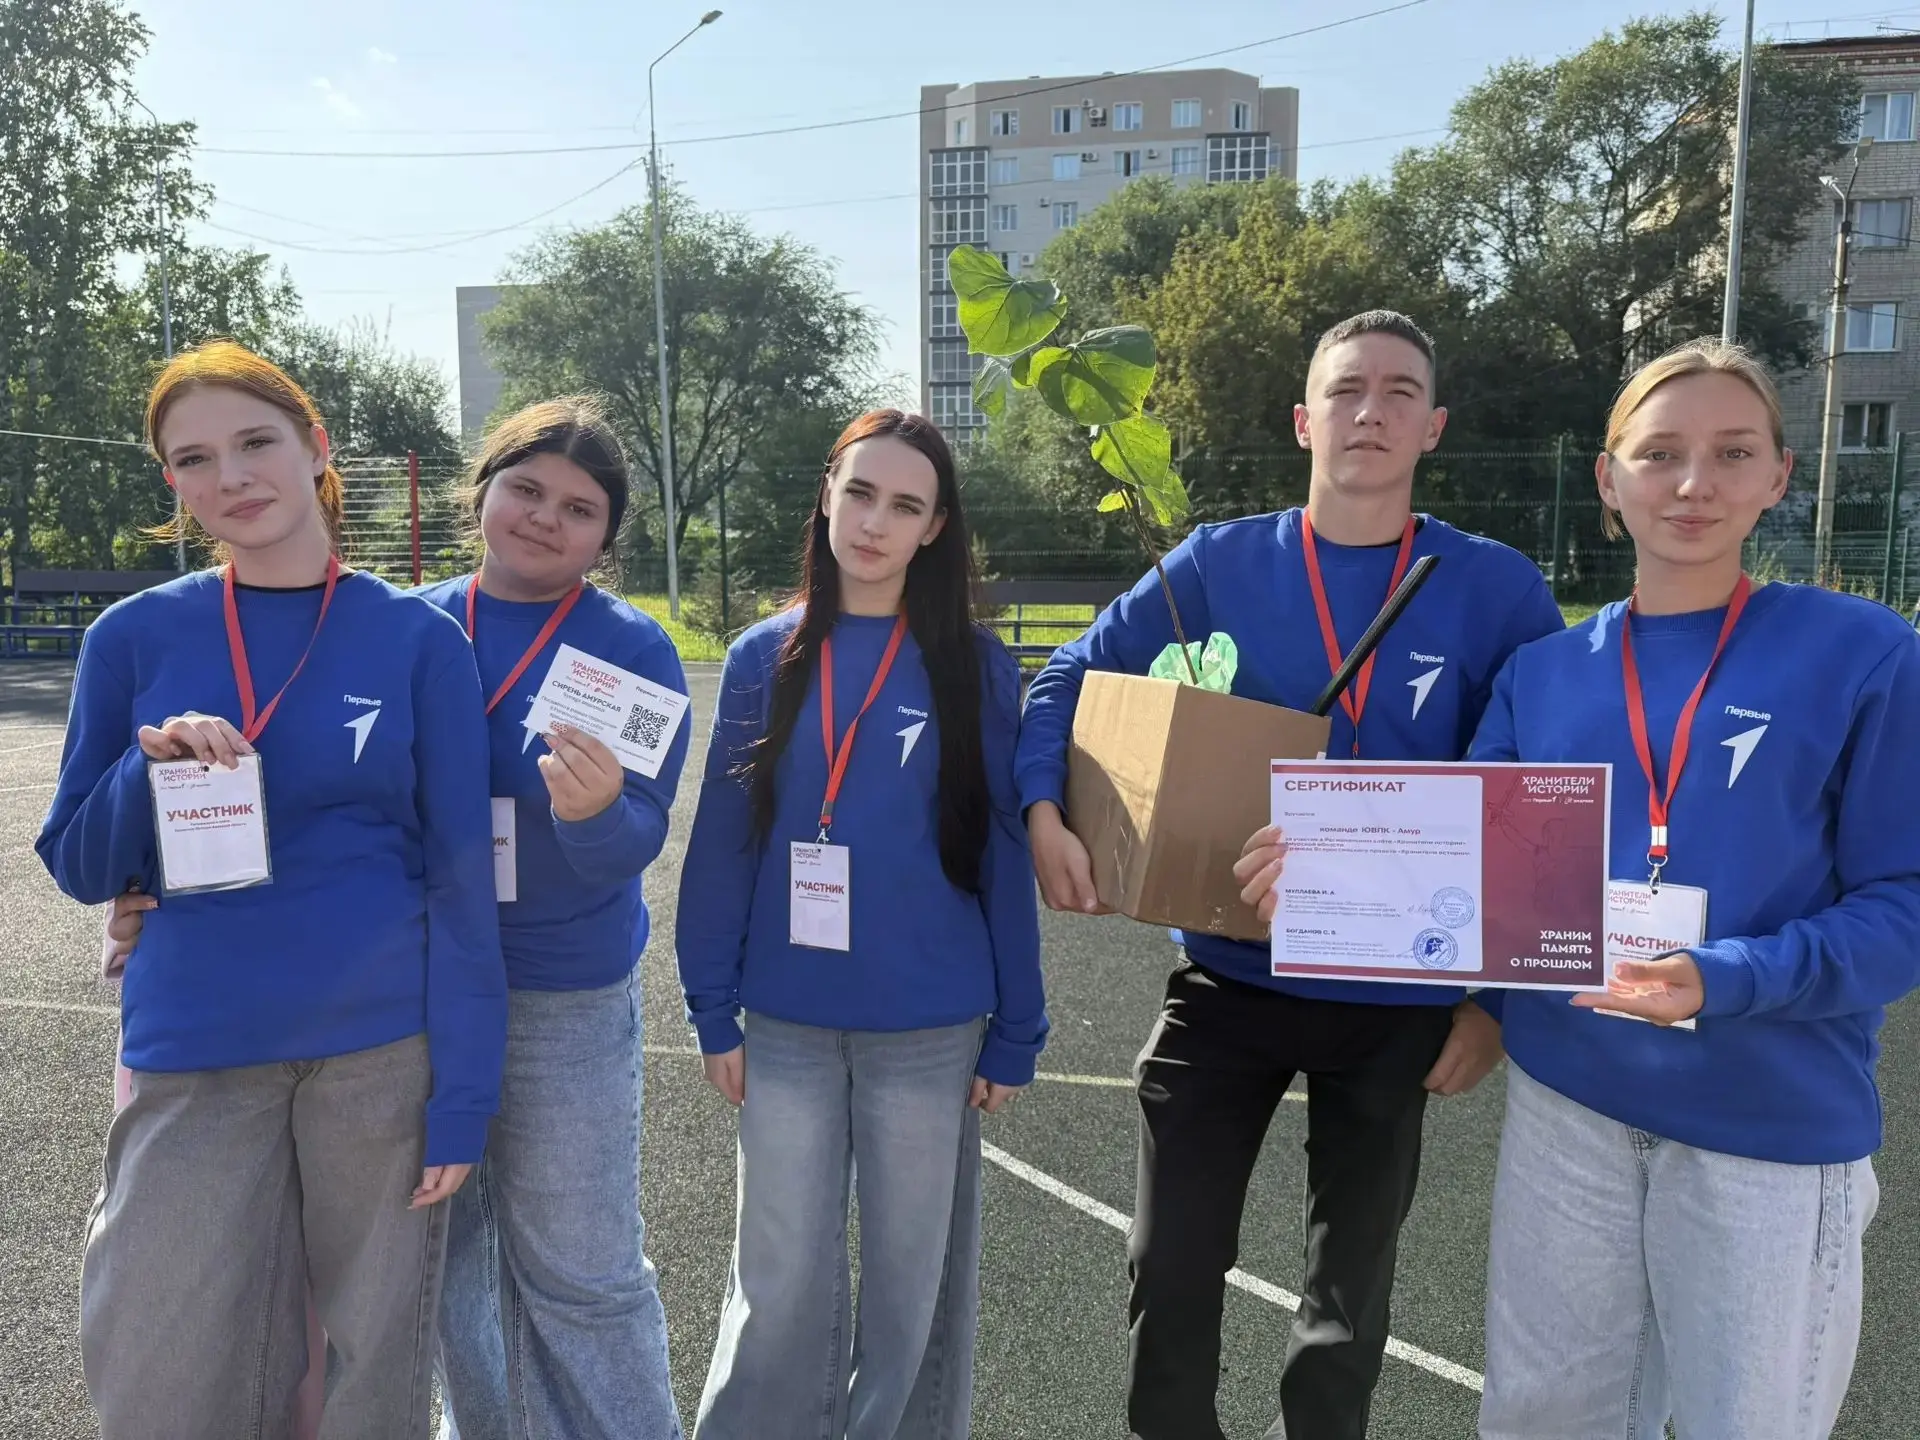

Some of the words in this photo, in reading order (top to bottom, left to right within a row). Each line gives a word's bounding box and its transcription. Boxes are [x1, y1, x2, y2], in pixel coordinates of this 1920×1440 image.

[571, 660, 621, 686] ХРАНИТЕЛИ
[572, 668, 615, 690] ИСТОРИИ
[343, 694, 382, 706] Первые
[552, 680, 581, 697] СИРЕНЬ
[582, 693, 622, 712] АМУРСКАЯ
[1724, 705, 1771, 721] Первые
[159, 766, 209, 777] ХРАНИТЕЛ
[164, 773, 207, 782] ИСТОРИИ
[1284, 780, 1406, 793] СЕРТИФИКАТ
[1522, 776, 1595, 786] ХРАНИТЕЛИ
[1528, 785, 1589, 794] ИСТОРИИ
[166, 803, 254, 822] УЧАСТНИК
[795, 880, 844, 894] УЧАСТНИК
[1608, 888, 1652, 900] РАНИТЕЛИ
[1540, 930, 1592, 941] ХРАНИМ
[1541, 943, 1593, 954] ПАМЯТЬ
[1510, 957, 1520, 967] О
[1524, 958, 1592, 970] ПРОШЛОМ
